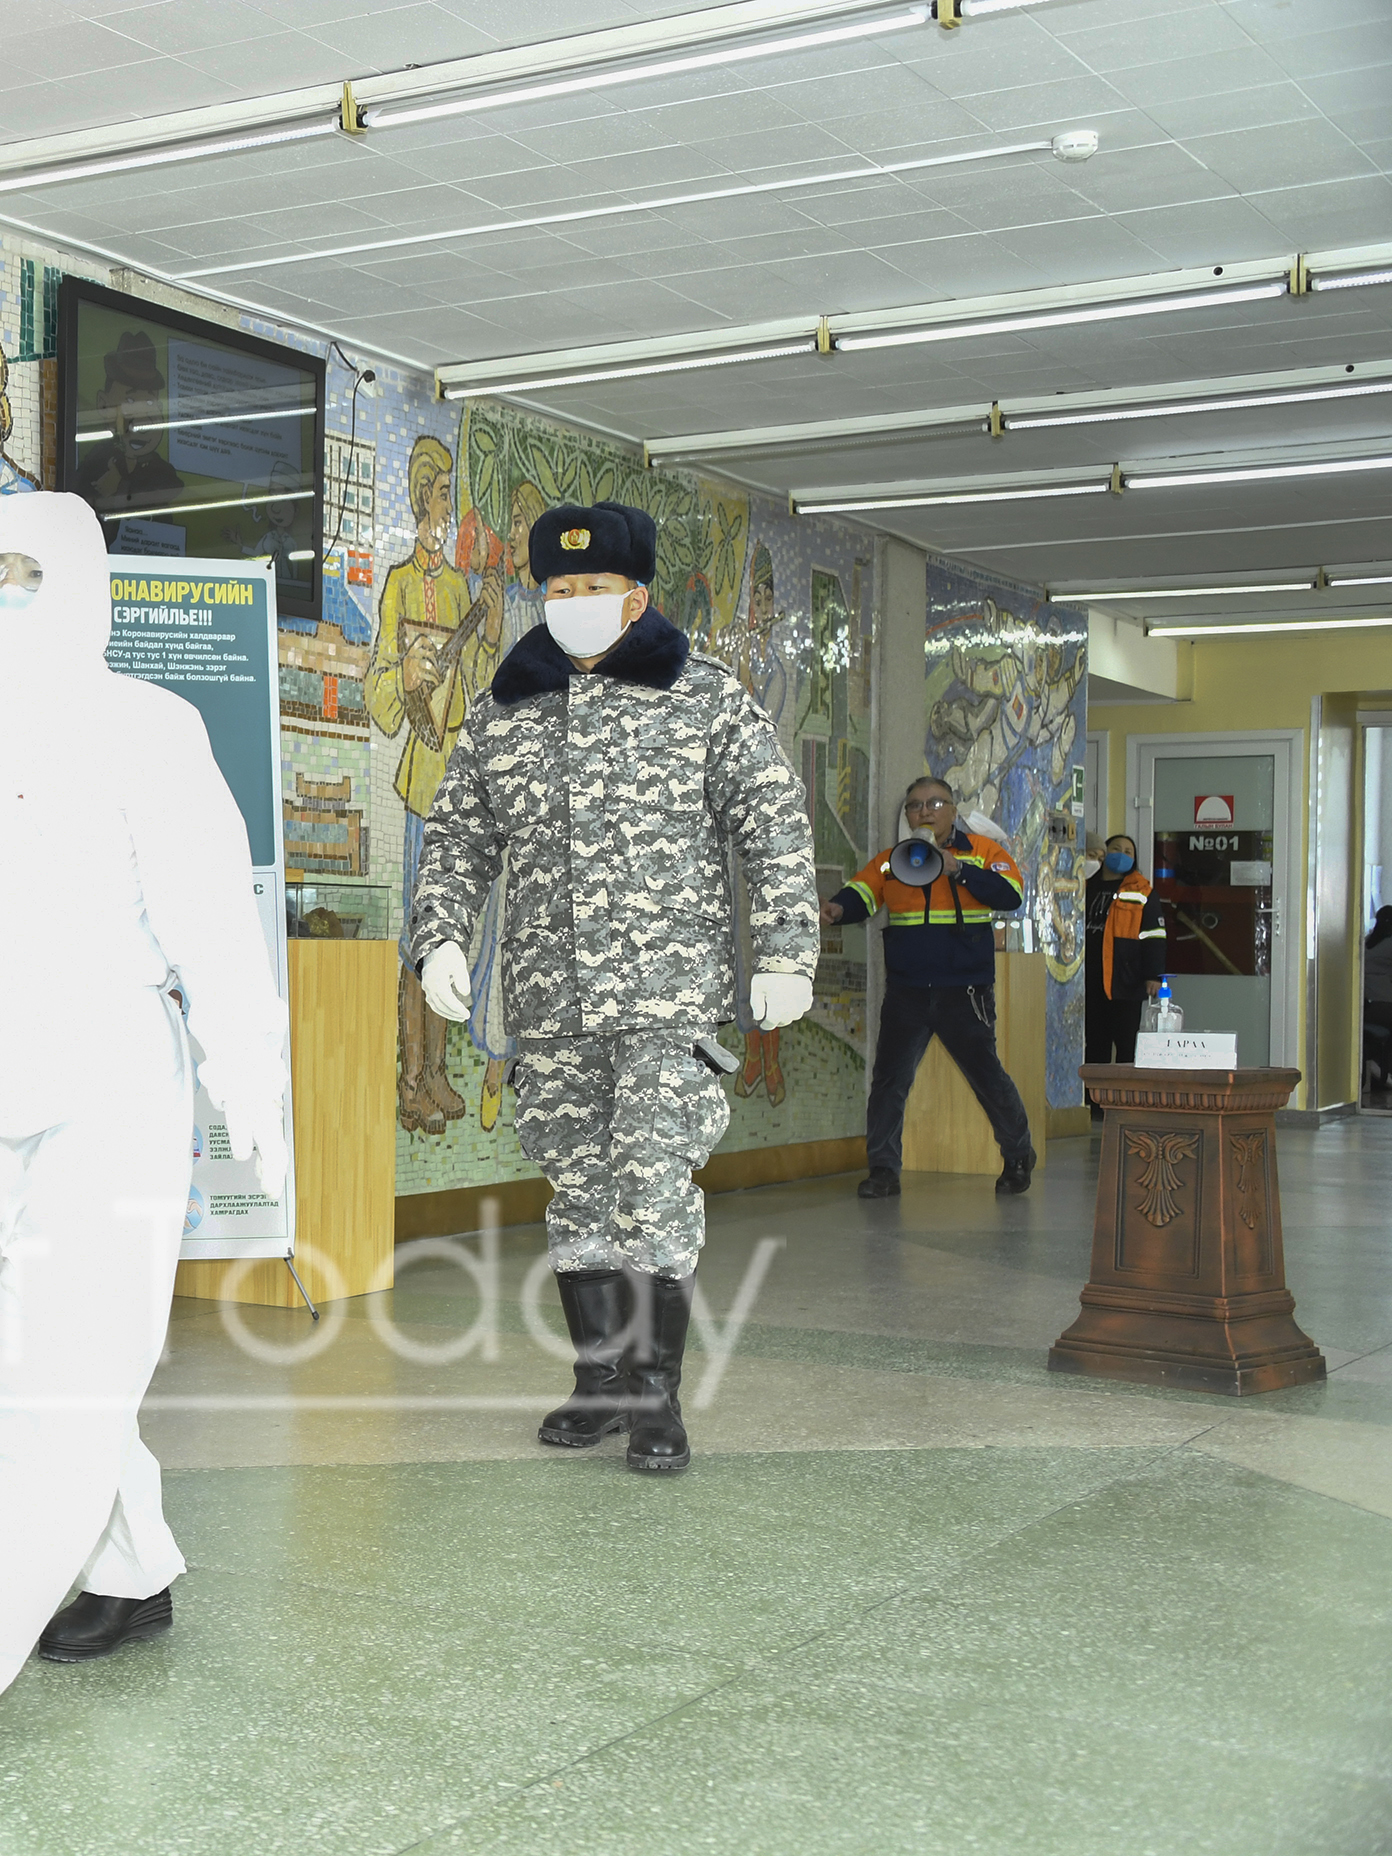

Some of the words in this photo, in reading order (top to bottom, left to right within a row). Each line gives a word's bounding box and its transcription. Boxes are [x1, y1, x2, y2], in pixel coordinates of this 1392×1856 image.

[113, 605, 213, 626] СЭРГИЙЛЬЕ!!!
[122, 629, 188, 640] Коронавирусийн
[189, 632, 236, 642] халдвараар
[134, 640, 164, 650] байдал
[164, 642, 185, 651] хүнд
[185, 641, 214, 651] байгаа,
[132, 651, 146, 660] тус
[146, 651, 161, 660] тус
[161, 651, 167, 659] 1
[168, 653, 183, 661] хүн
[223, 652, 250, 662] байна.
[132, 660, 166, 671] Шанхай,
[205, 664, 228, 673] зэрэг
[164, 672, 185, 681] байж
[186, 673, 229, 684] болзошгүй
[229, 674, 257, 682] байна.
[1188, 834, 1240, 851] №01
